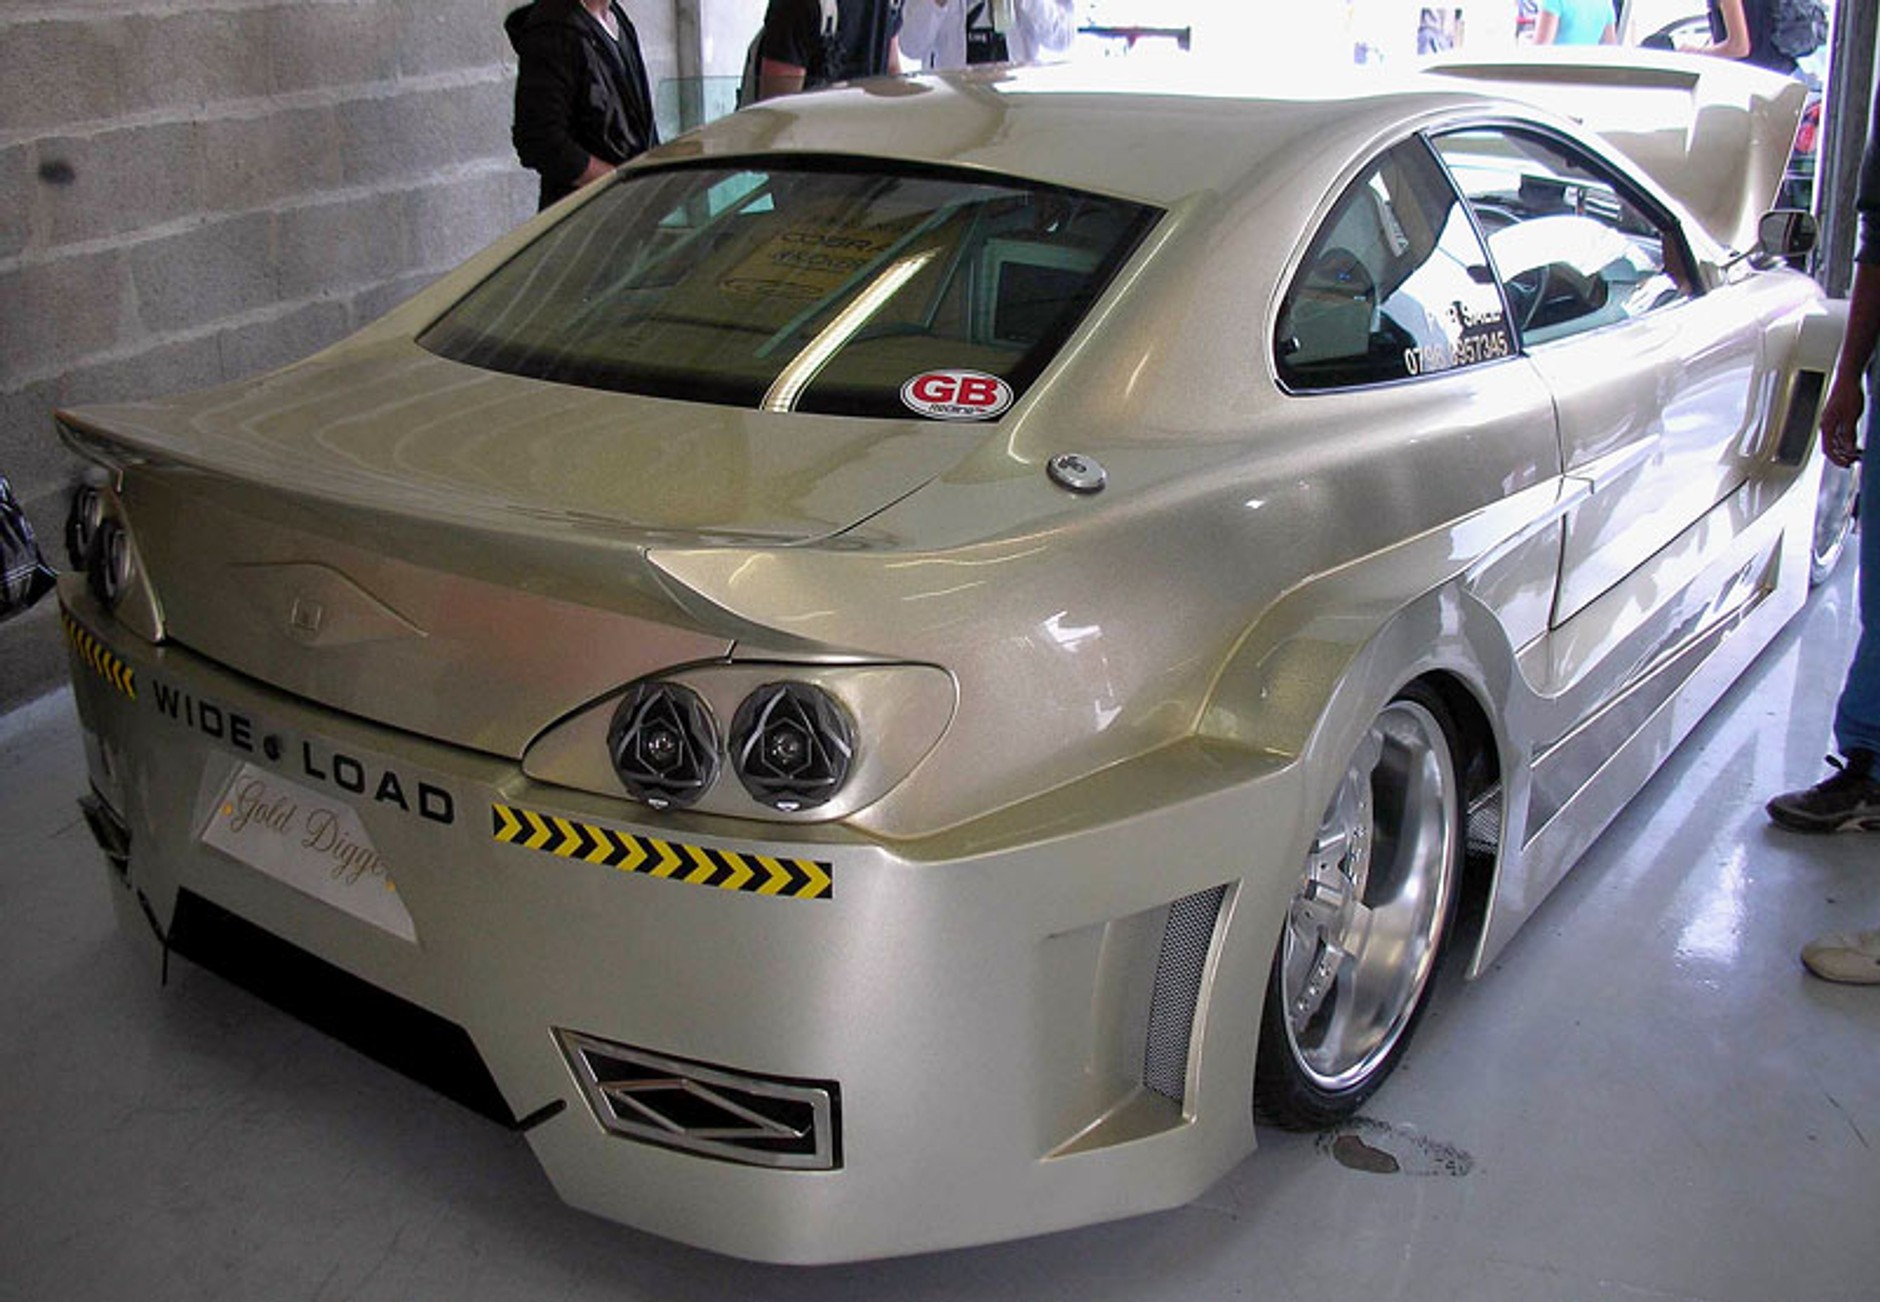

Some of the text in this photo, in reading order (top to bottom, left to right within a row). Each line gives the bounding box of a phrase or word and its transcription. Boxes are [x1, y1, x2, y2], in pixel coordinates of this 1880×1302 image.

[911, 373, 998, 407] GB
[152, 680, 455, 825] WIDE LOAD
[229, 778, 386, 885] Gold Digge
